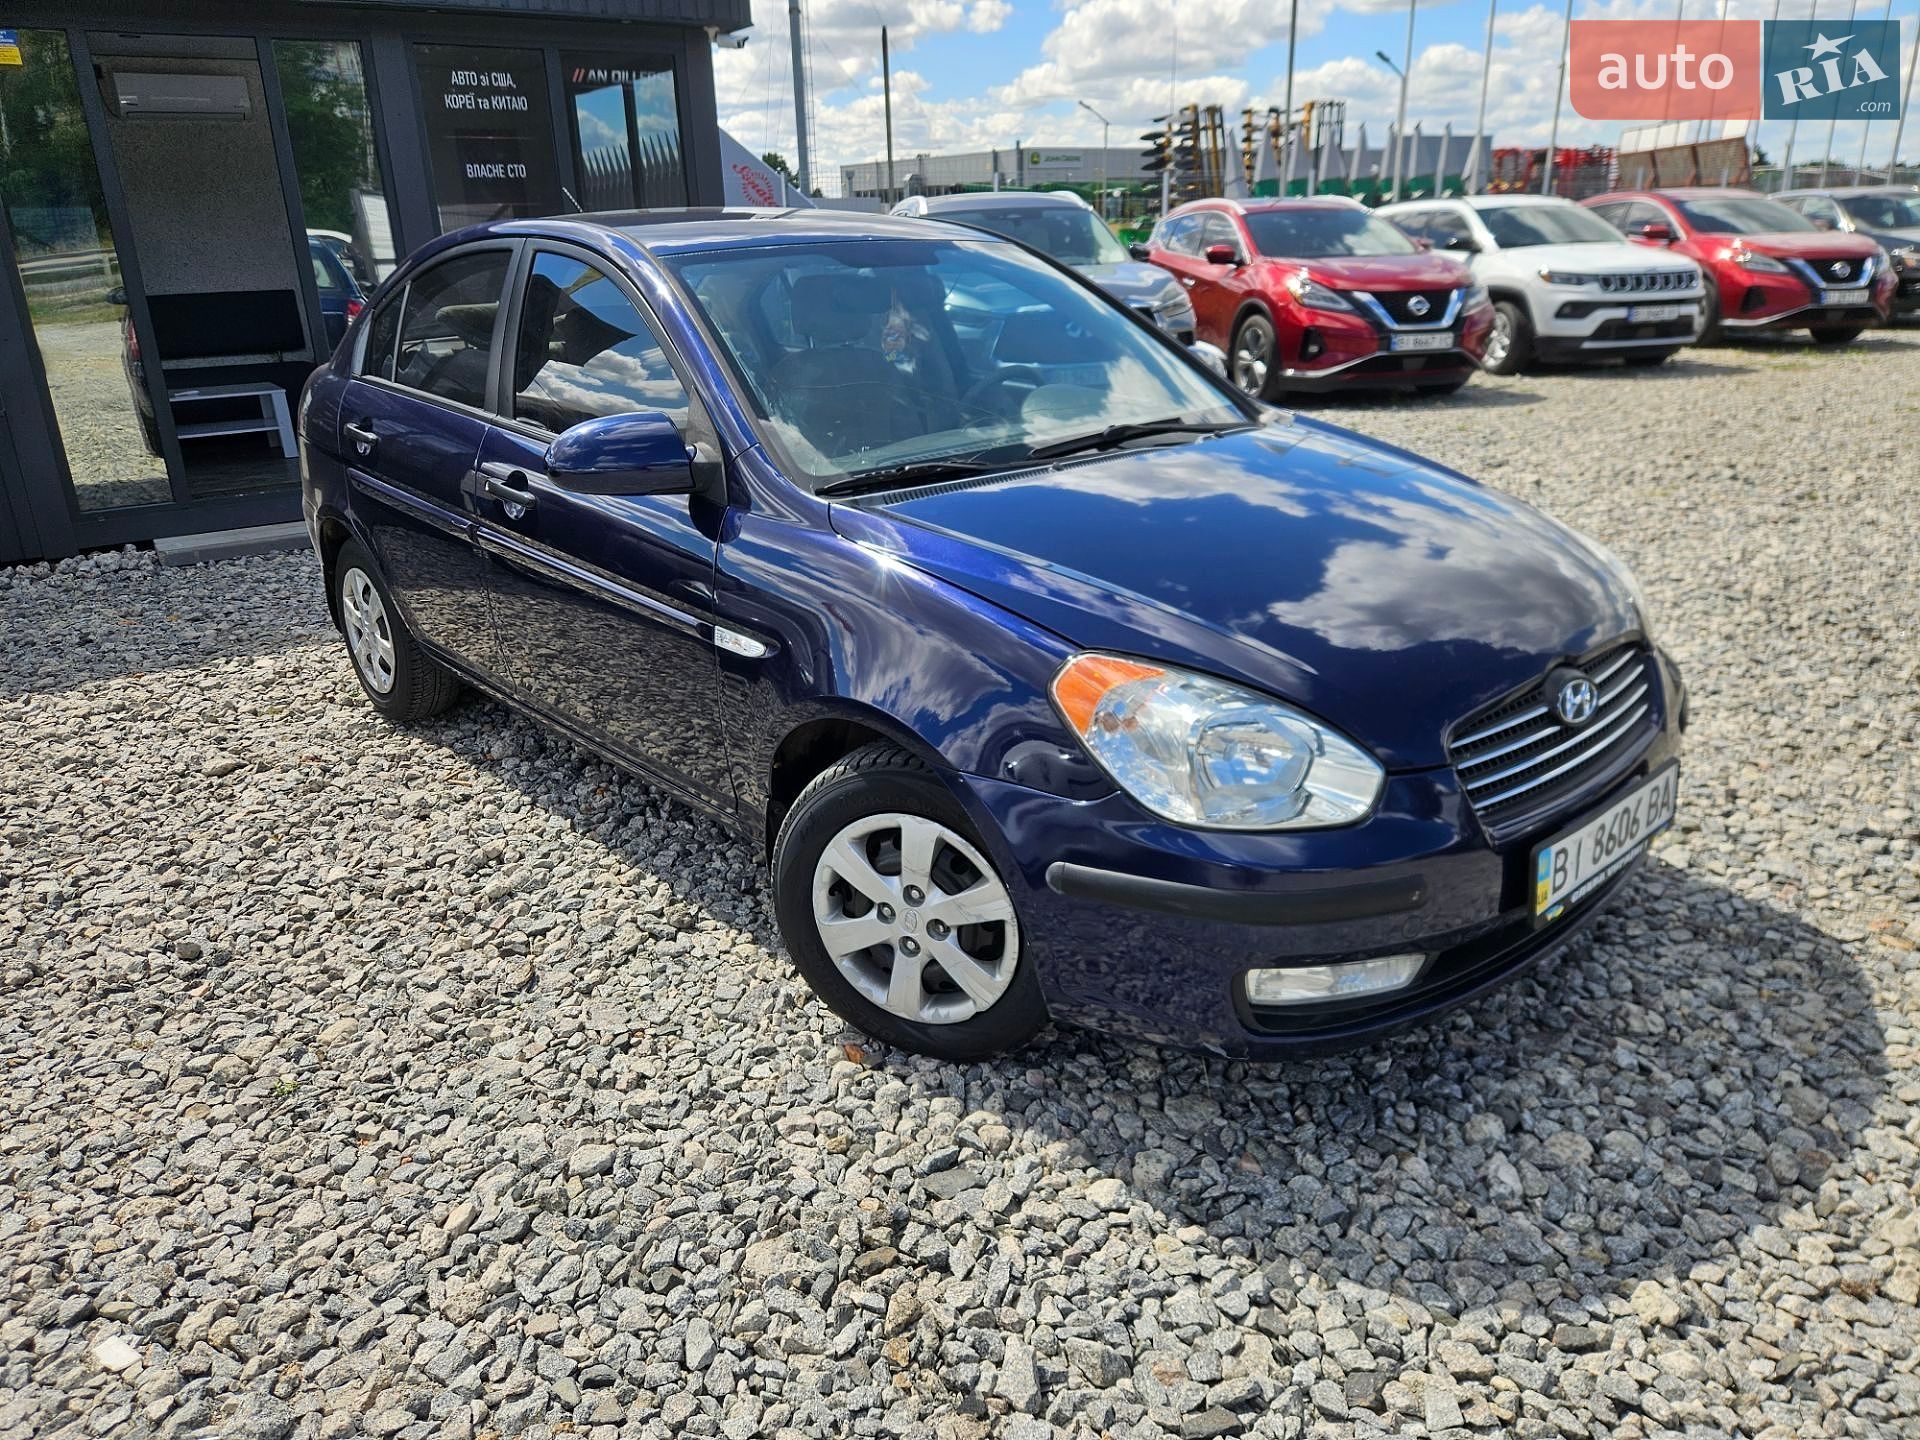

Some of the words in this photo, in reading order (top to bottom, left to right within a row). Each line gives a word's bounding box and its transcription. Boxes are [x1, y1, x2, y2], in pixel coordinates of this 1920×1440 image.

[451, 71, 478, 86] АВТО
[480, 72, 490, 86] зі
[491, 72, 516, 88] США,
[587, 69, 607, 82] AN
[444, 92, 475, 109] КОРЕЇ
[477, 98, 490, 110] та
[491, 95, 528, 111] КИТАЮ
[466, 163, 506, 178] ВЛАСНЕ
[507, 164, 527, 178] СТО
[1552, 837, 1582, 895] BI
[1592, 797, 1643, 865] 8606
[1646, 775, 1671, 828] BA
